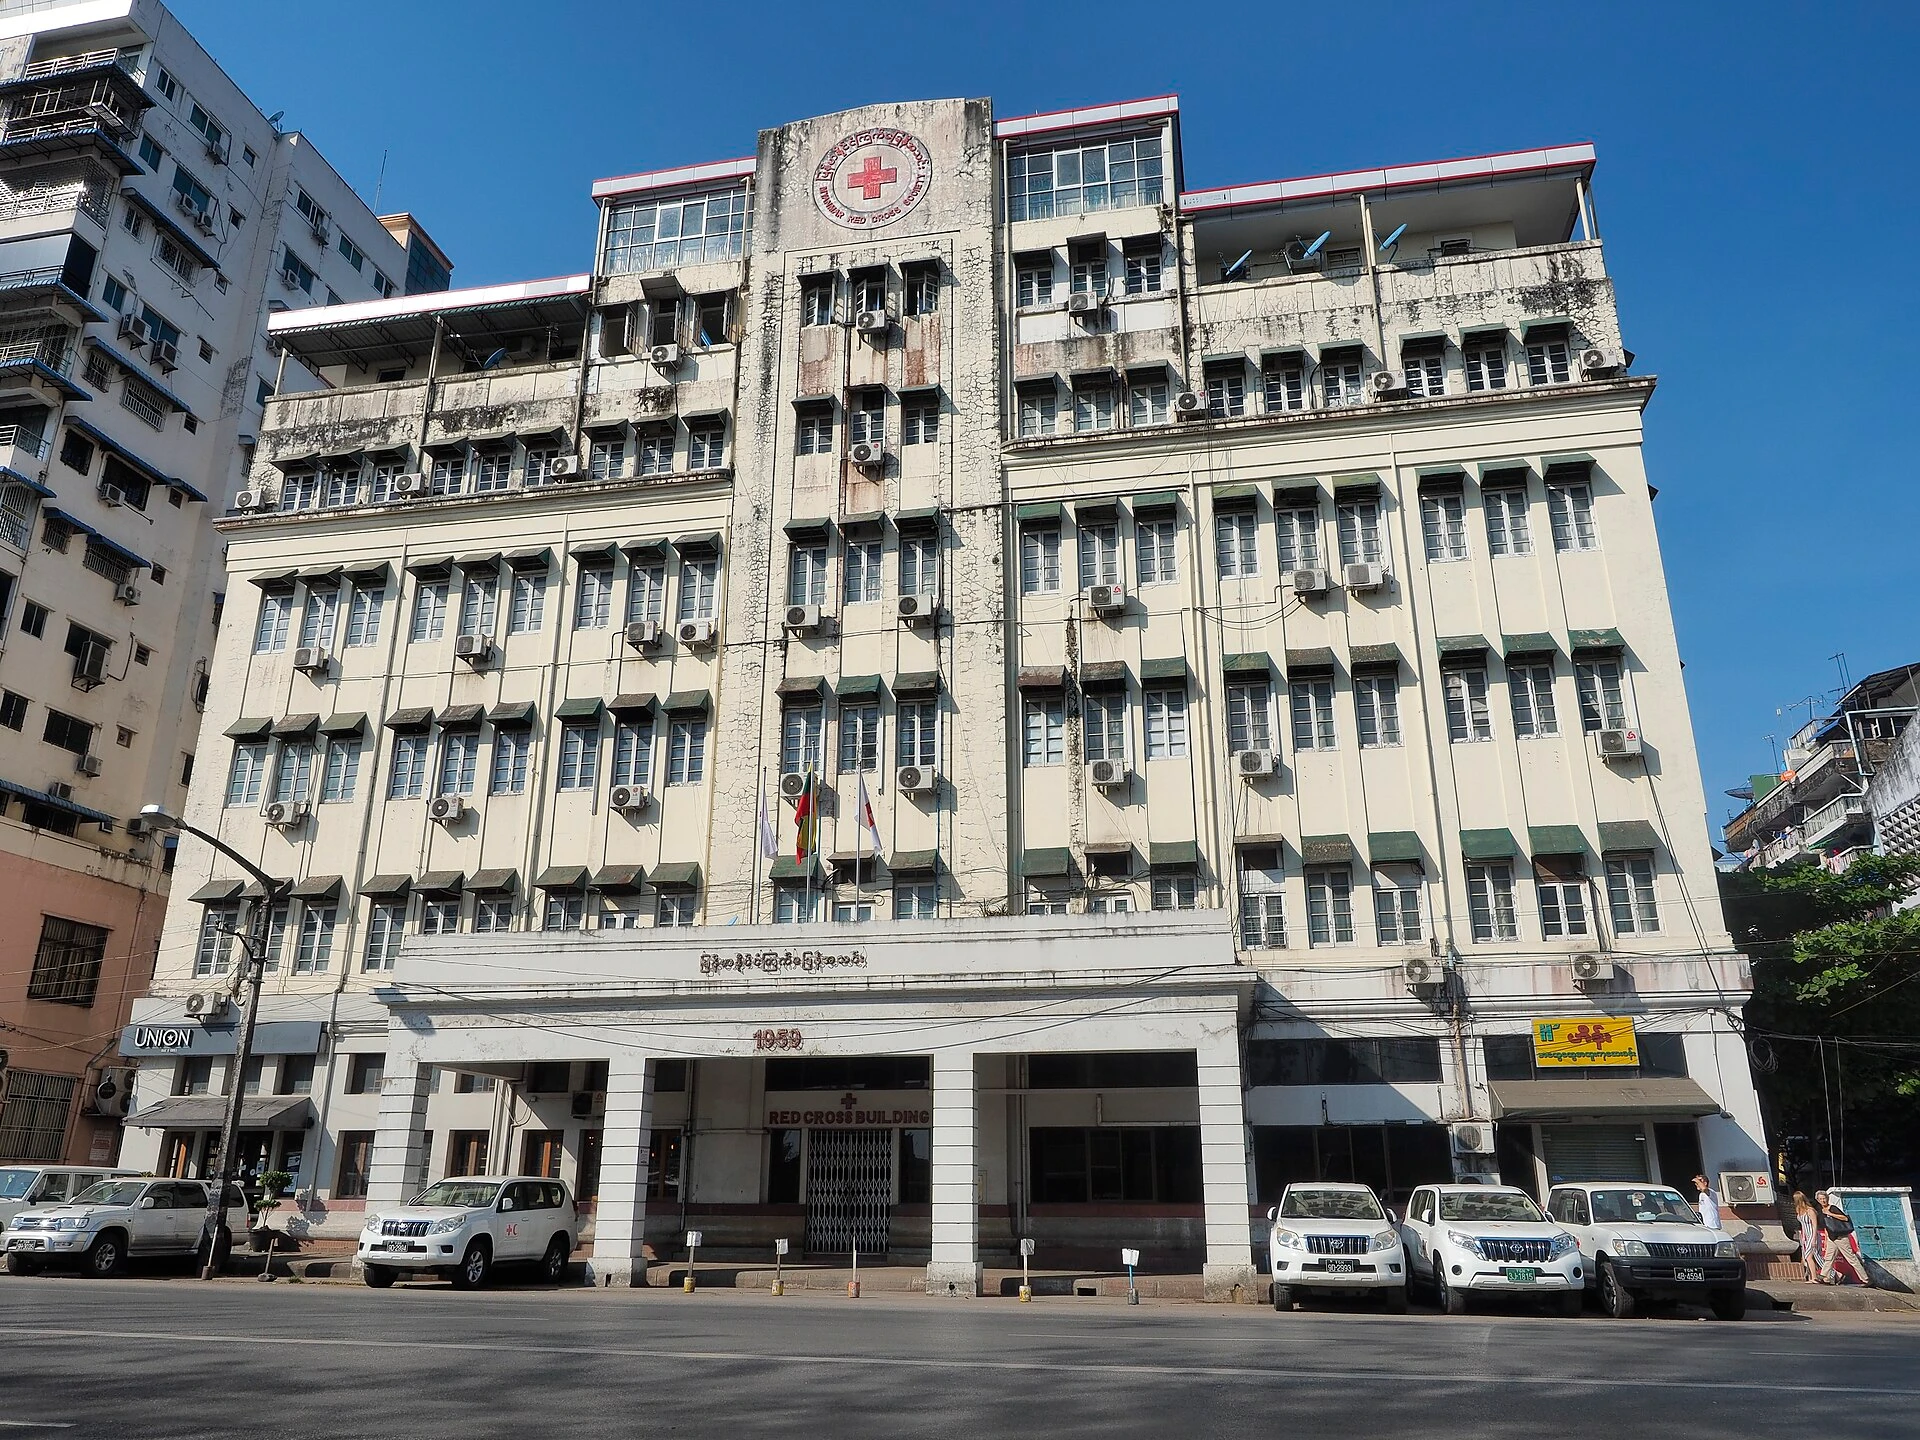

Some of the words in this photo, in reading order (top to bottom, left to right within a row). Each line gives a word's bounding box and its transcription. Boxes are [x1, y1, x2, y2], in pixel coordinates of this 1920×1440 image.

[820, 186, 845, 219] MYANMAR
[847, 215, 867, 225] RED
[872, 206, 902, 224] CROSS
[903, 174, 926, 207] SOCIETY
[135, 1027, 192, 1048] UNION
[753, 1028, 803, 1050] 1959
[769, 1110, 800, 1124] RED
[803, 1110, 853, 1124] CROSS
[855, 1110, 930, 1125] BUILDING
